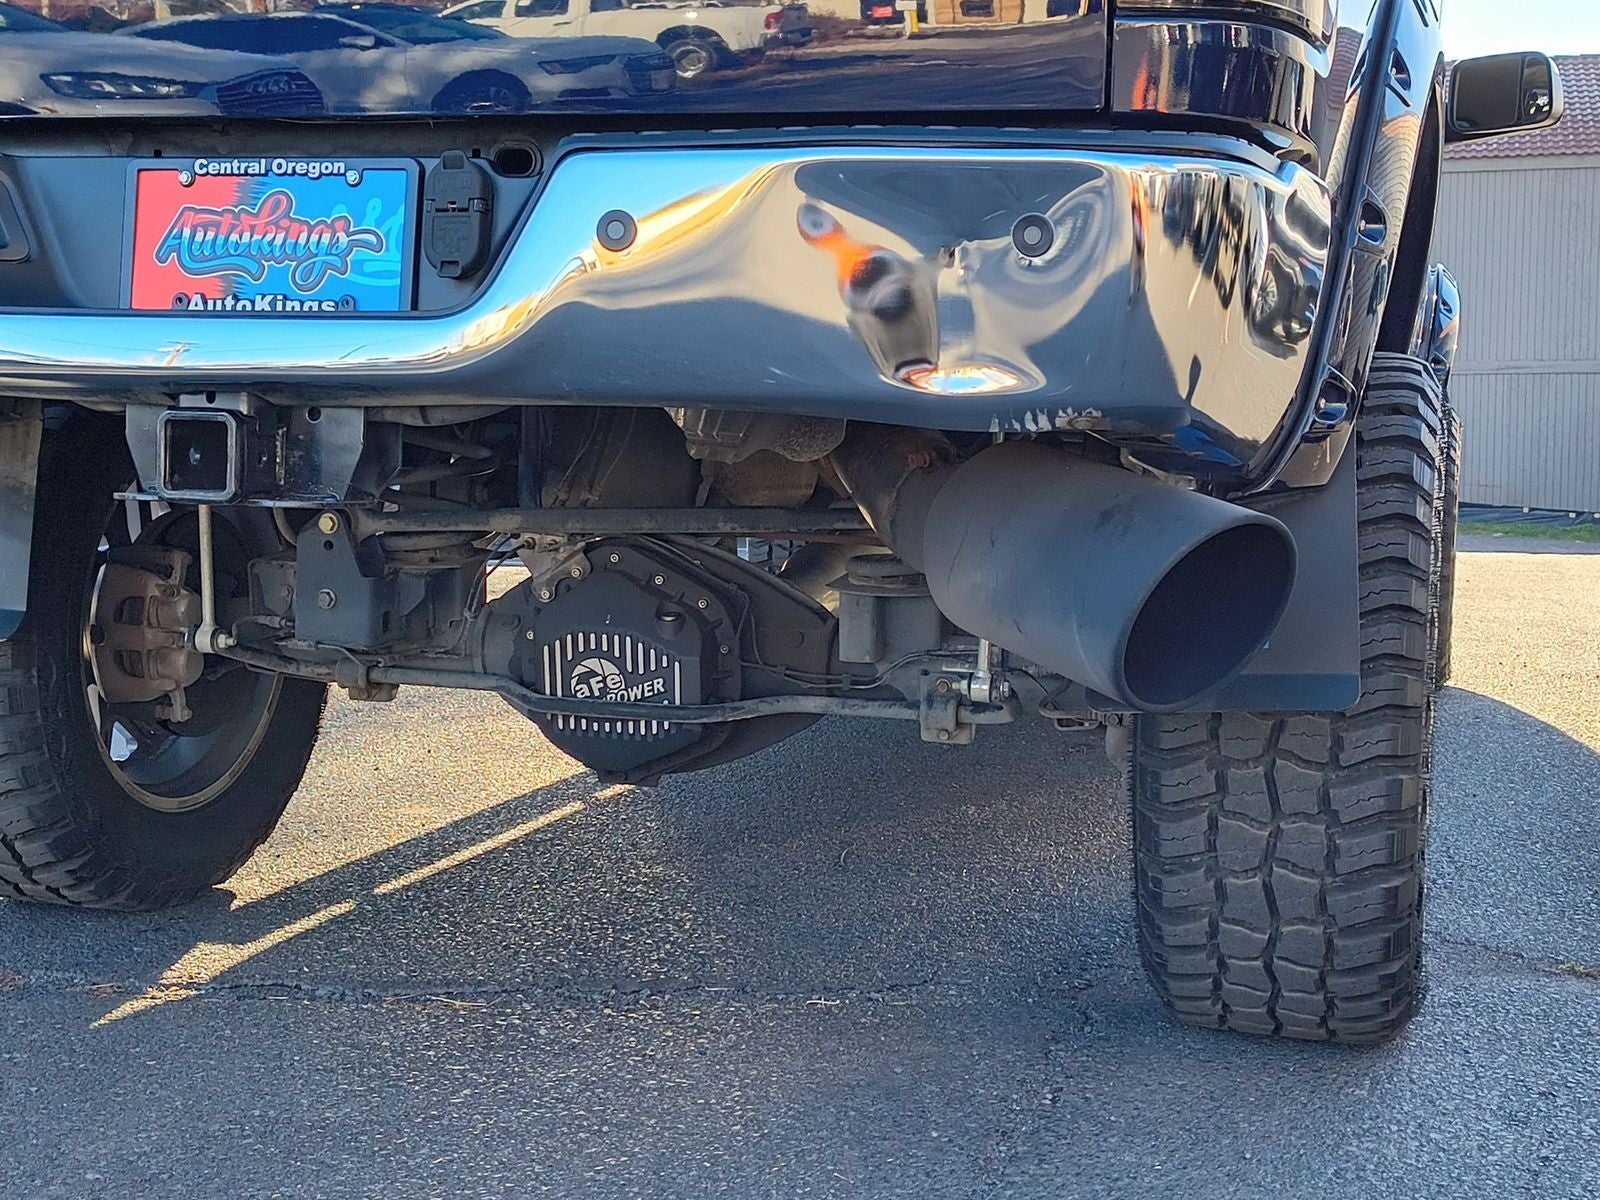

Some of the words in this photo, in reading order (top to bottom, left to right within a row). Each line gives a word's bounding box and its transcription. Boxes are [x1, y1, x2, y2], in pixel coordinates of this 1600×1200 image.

[193, 158, 265, 175] Central
[271, 158, 346, 177] Oregon
[187, 294, 336, 312] AutoKings
[575, 674, 621, 698] aFe
